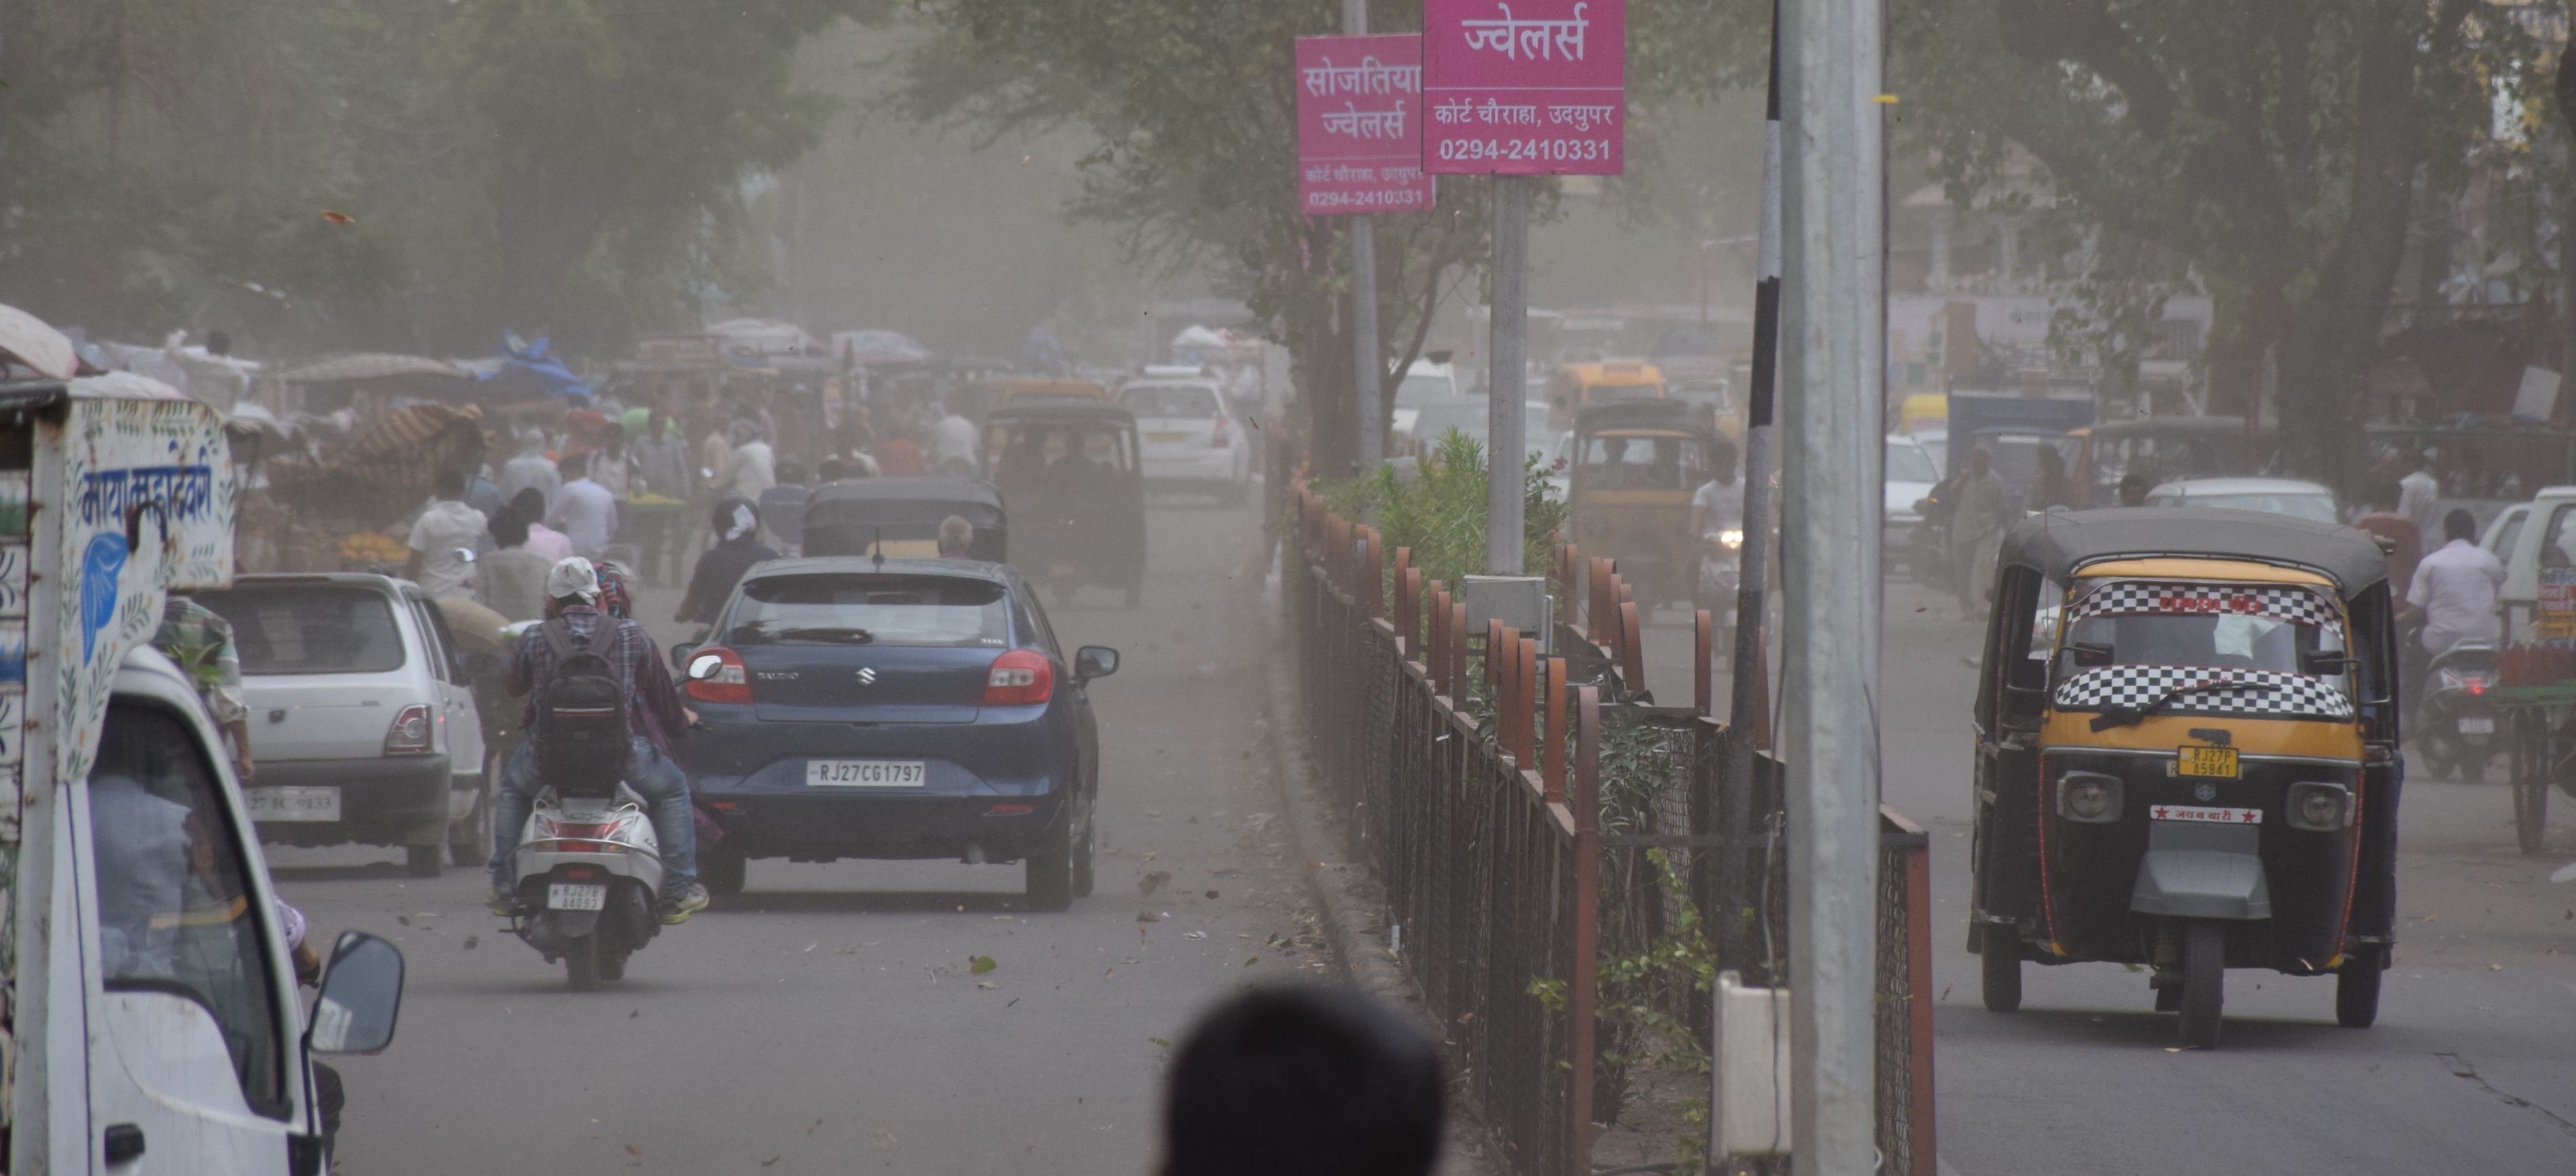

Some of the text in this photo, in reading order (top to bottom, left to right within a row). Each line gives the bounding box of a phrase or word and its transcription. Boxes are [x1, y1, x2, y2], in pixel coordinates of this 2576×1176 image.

[1461, 2, 1589, 61] ज्वेलर्स
[1303, 55, 1422, 96] सोजतिया
[1322, 100, 1406, 138] ज्वेलर्स
[1434, 98, 1615, 131] कोर्ट चौराहा, उदयुपर
[1440, 139, 1609, 160] 0294-2410331
[1309, 190, 1422, 206] 0294-2410331
[2194, 749, 2230, 762] RJ27P
[820, 764, 922, 781] RJ27CG1797
